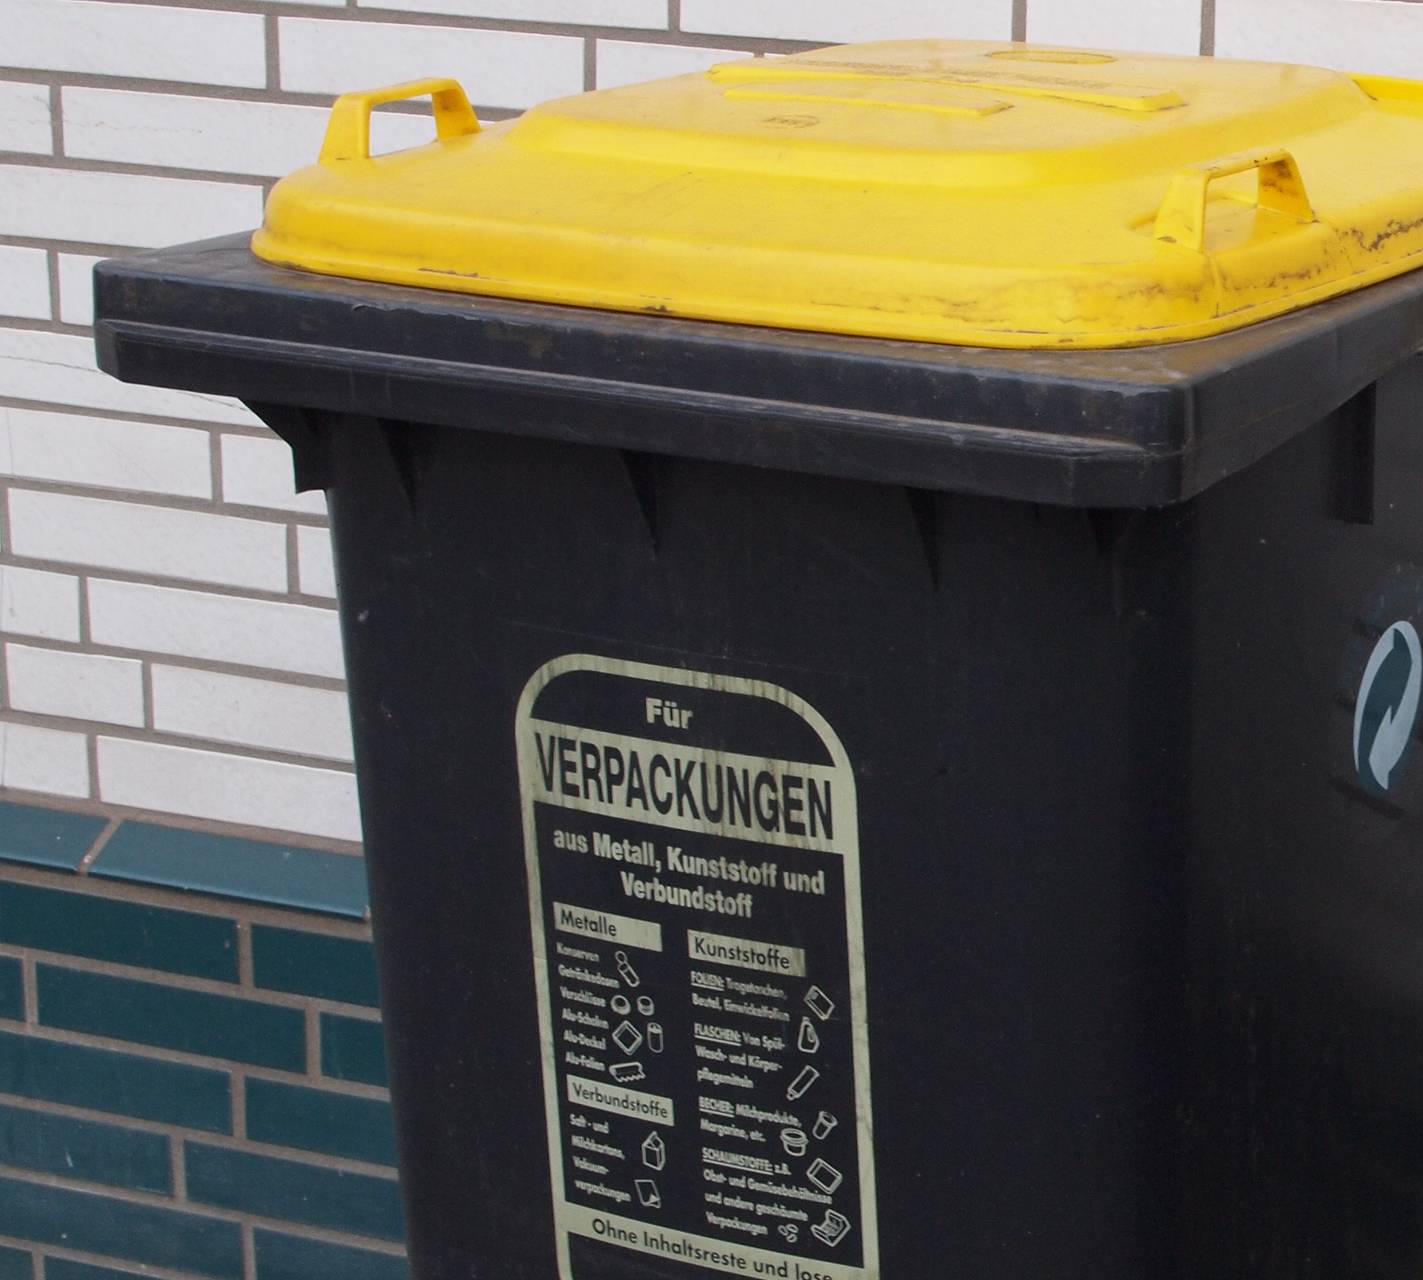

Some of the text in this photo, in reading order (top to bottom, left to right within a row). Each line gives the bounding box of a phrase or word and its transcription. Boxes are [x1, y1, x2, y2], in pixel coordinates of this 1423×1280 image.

[645, 696, 693, 730] Für
[534, 732, 834, 840] VERPACKUNGEN
[553, 828, 826, 896] aus Metall, Kunststoff und
[620, 871, 753, 918] Verbundstoff
[561, 909, 617, 937] Metalle
[695, 936, 791, 970] Kunststoffe
[573, 1082, 668, 1118] Verbundstoffe
[592, 1218, 637, 1244] Ohne
[644, 1232, 747, 1270] Inhaltsreste
[753, 1259, 788, 1279] und
